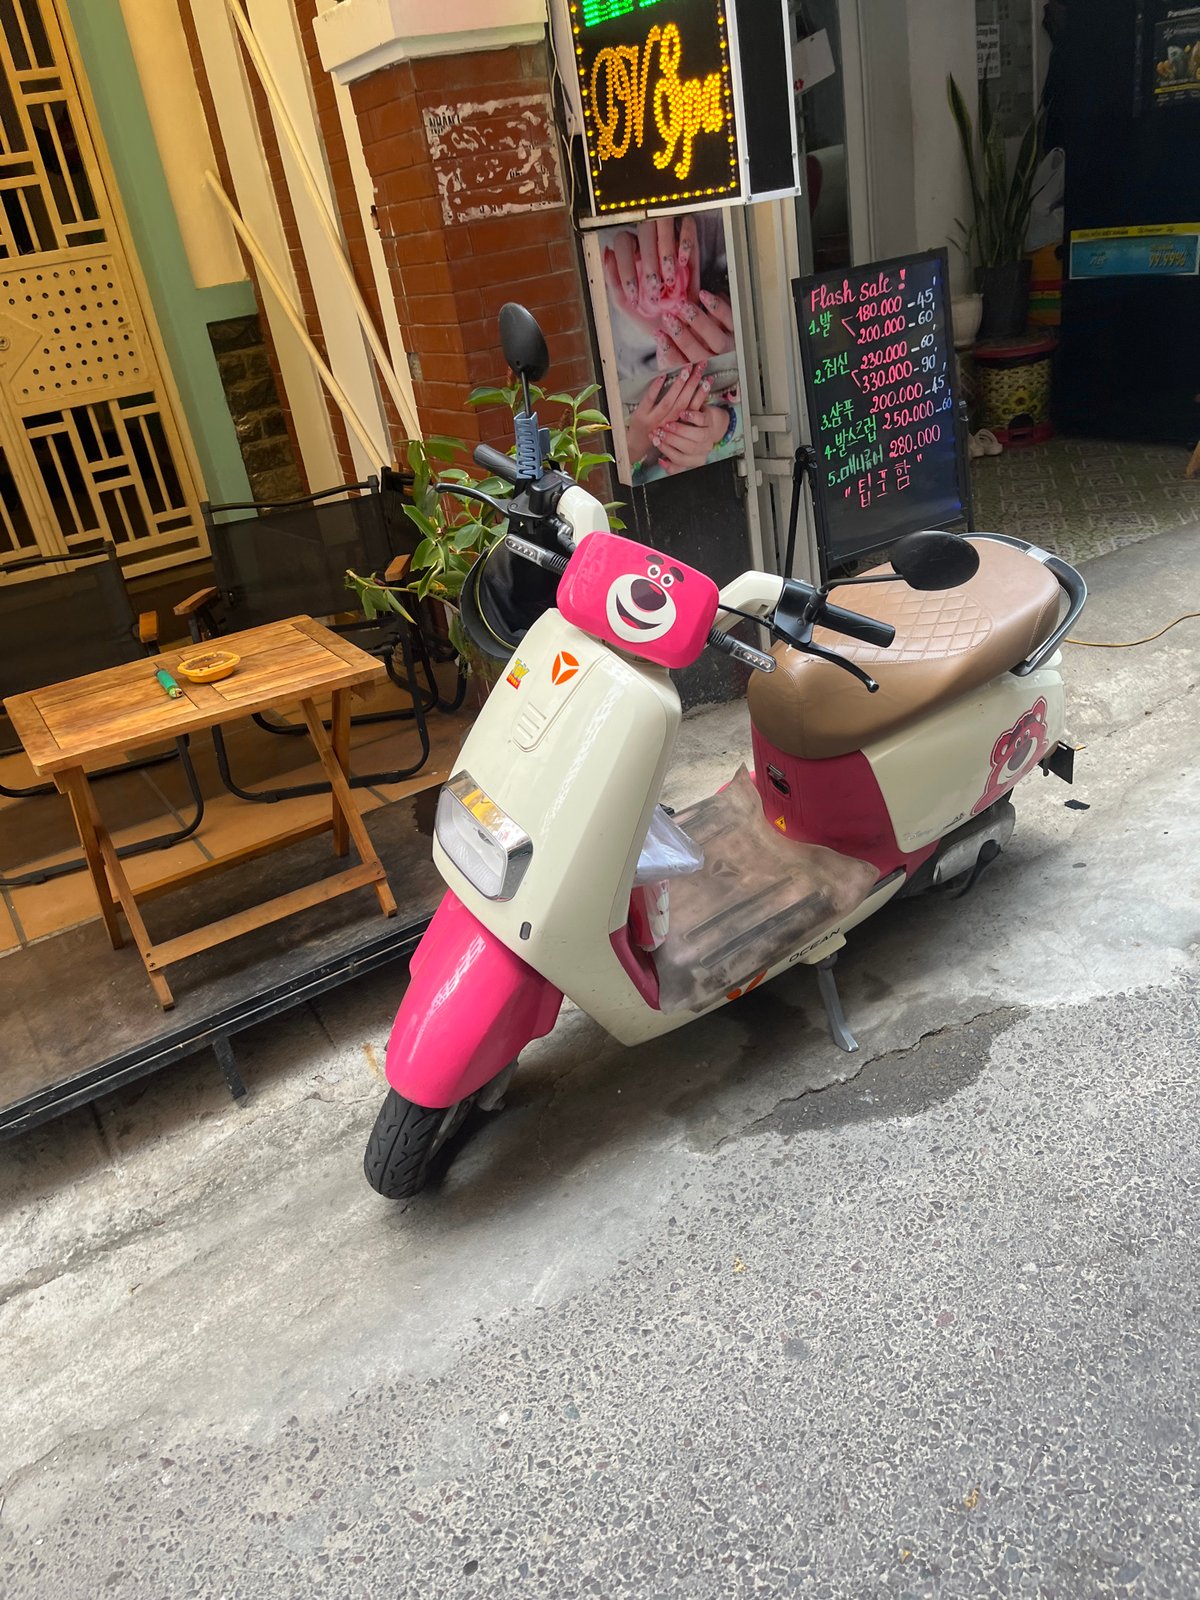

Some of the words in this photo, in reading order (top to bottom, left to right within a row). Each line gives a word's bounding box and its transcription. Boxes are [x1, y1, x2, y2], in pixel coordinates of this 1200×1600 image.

[811, 279, 856, 312] Flash
[855, 296, 902, 323] 180.000
[857, 315, 906, 345] 200.000
[860, 341, 907, 370] 230.000
[862, 360, 913, 394] 330.000
[869, 382, 923, 414] 200.000
[882, 400, 935, 430] 250.000
[888, 424, 942, 459] 280.000
[788, 927, 841, 963] OCEAN
